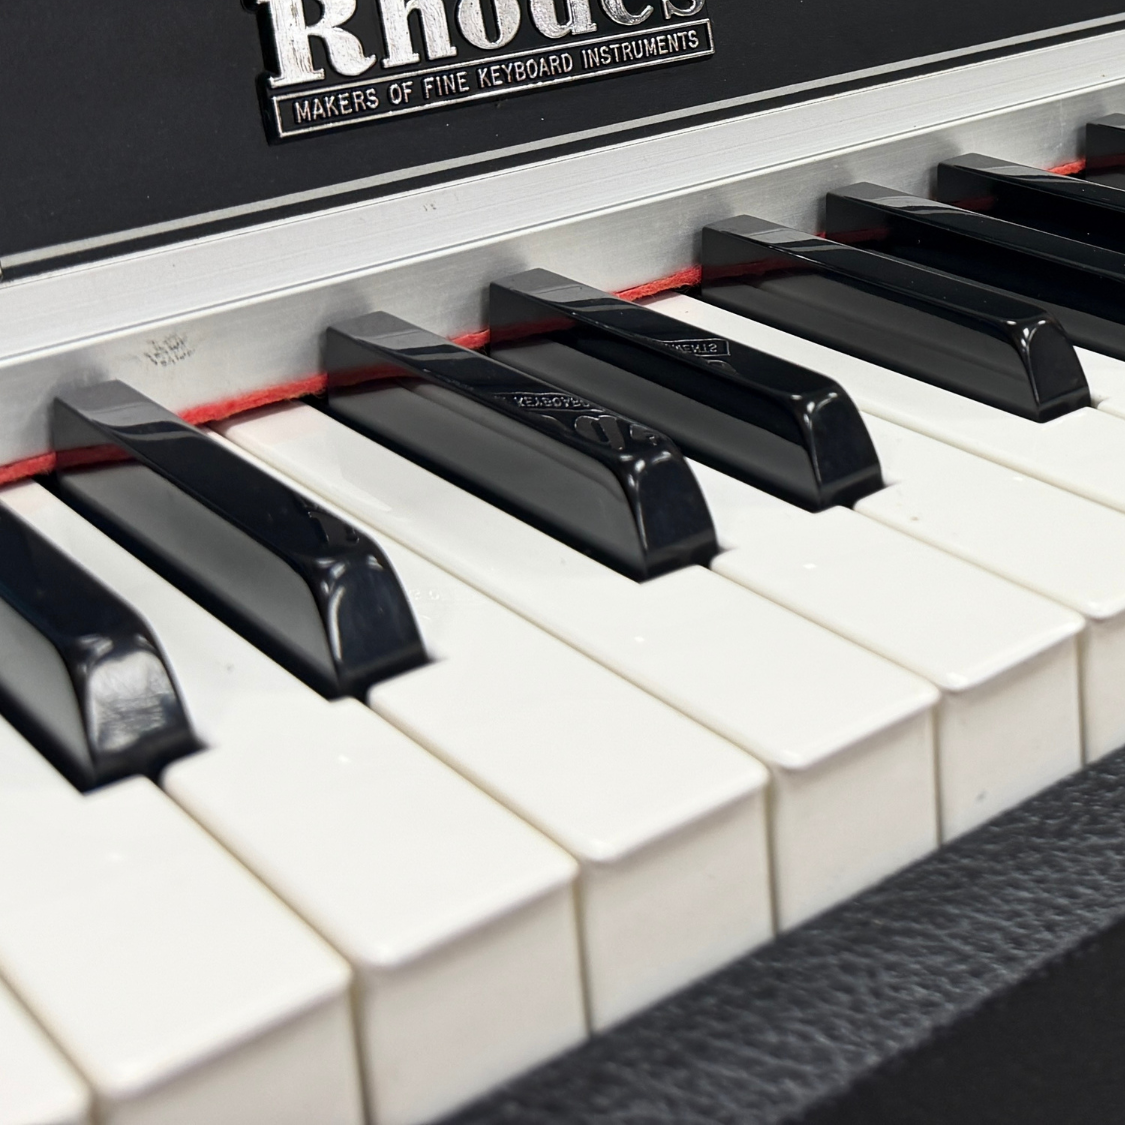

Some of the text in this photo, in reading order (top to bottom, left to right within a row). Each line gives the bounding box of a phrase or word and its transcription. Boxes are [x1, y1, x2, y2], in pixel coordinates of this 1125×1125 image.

[293, 30, 700, 124] MAKERS OF FINE KEYBOARD INSTRUMENTS
